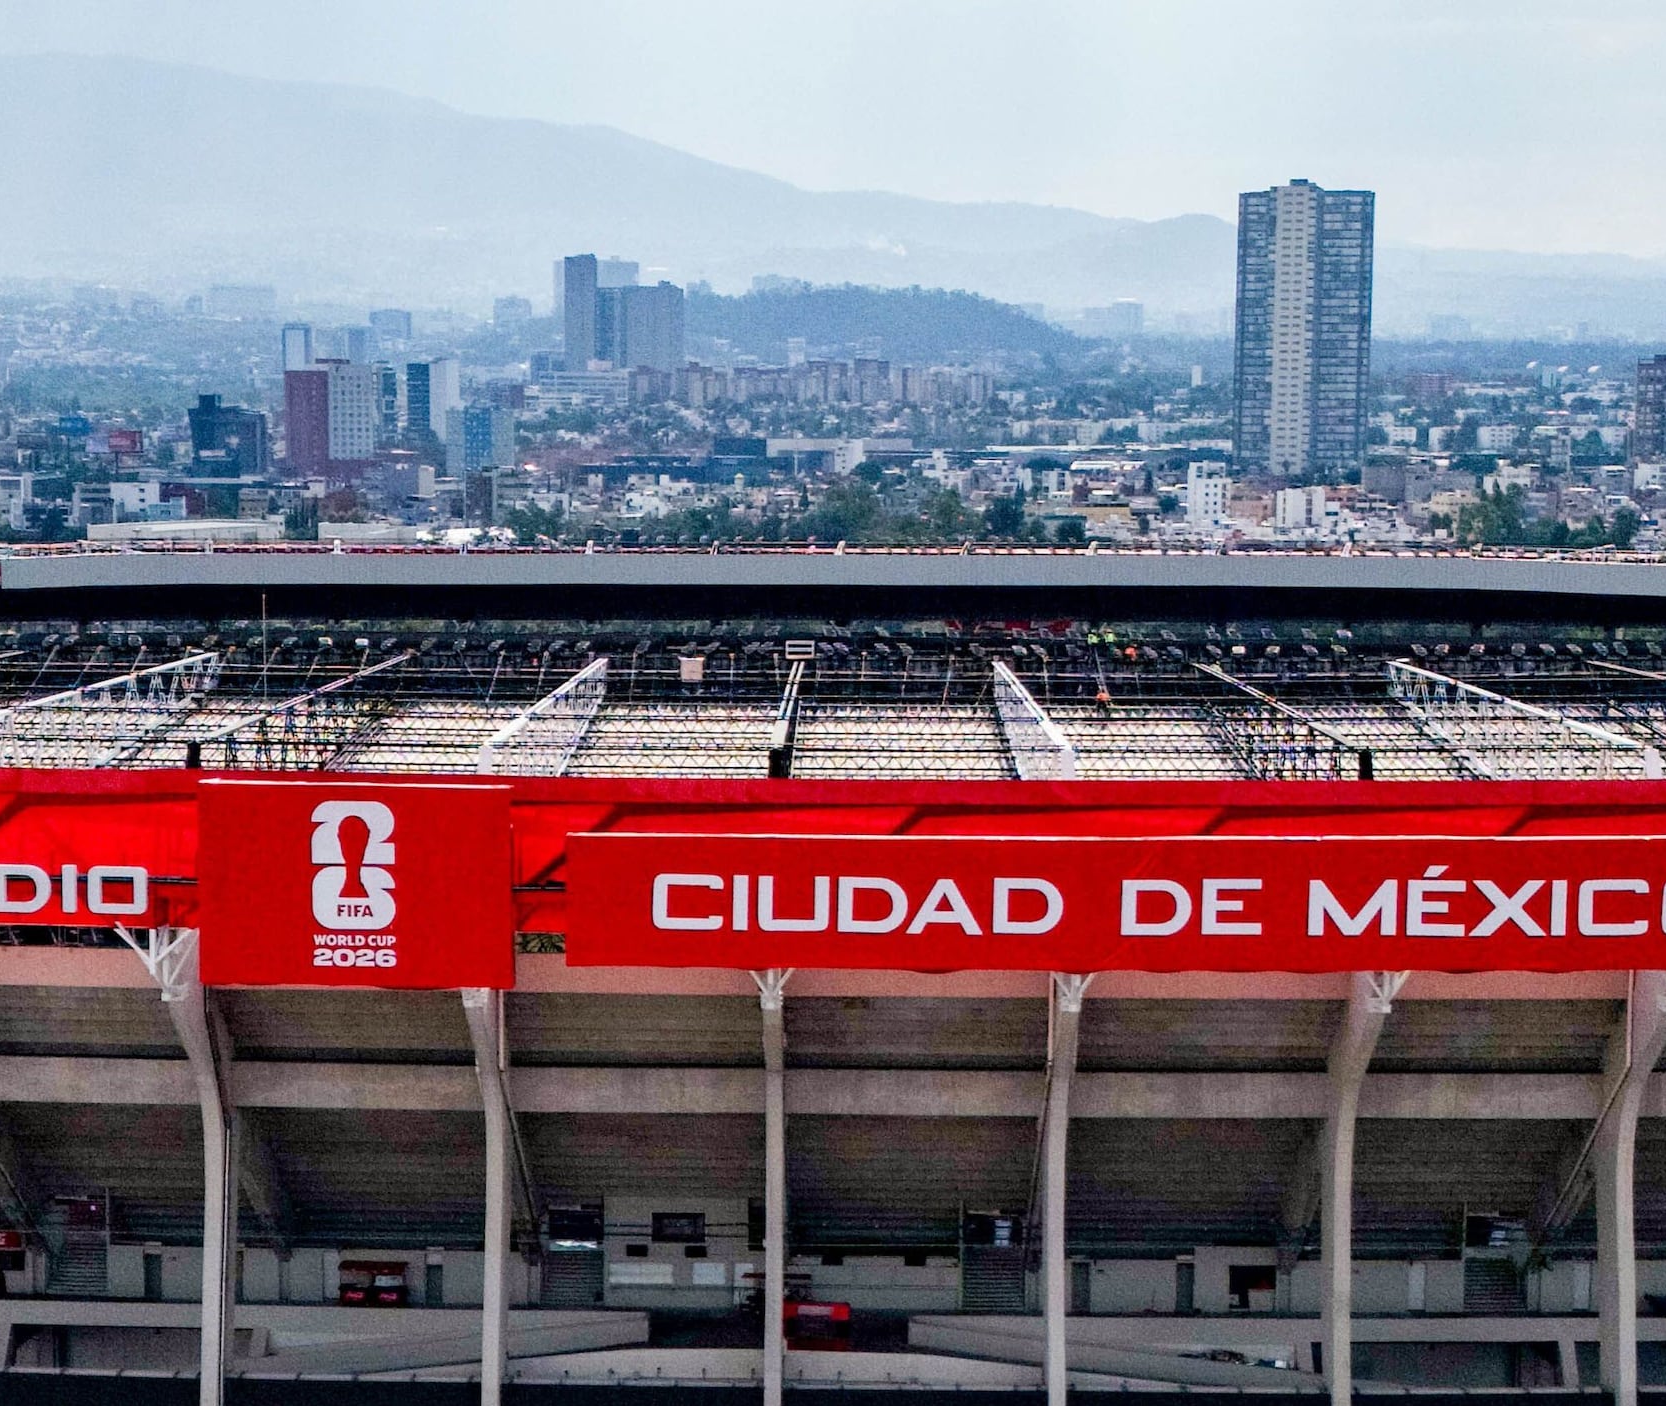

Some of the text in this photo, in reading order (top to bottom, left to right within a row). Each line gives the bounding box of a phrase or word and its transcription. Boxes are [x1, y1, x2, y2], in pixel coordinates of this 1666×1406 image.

[337, 904, 374, 918] FIFA
[651, 872, 1065, 938] CIUDAD
[1119, 876, 1264, 938] DE
[313, 934, 397, 947] WORLD CUP
[313, 948, 397, 968] 2026
